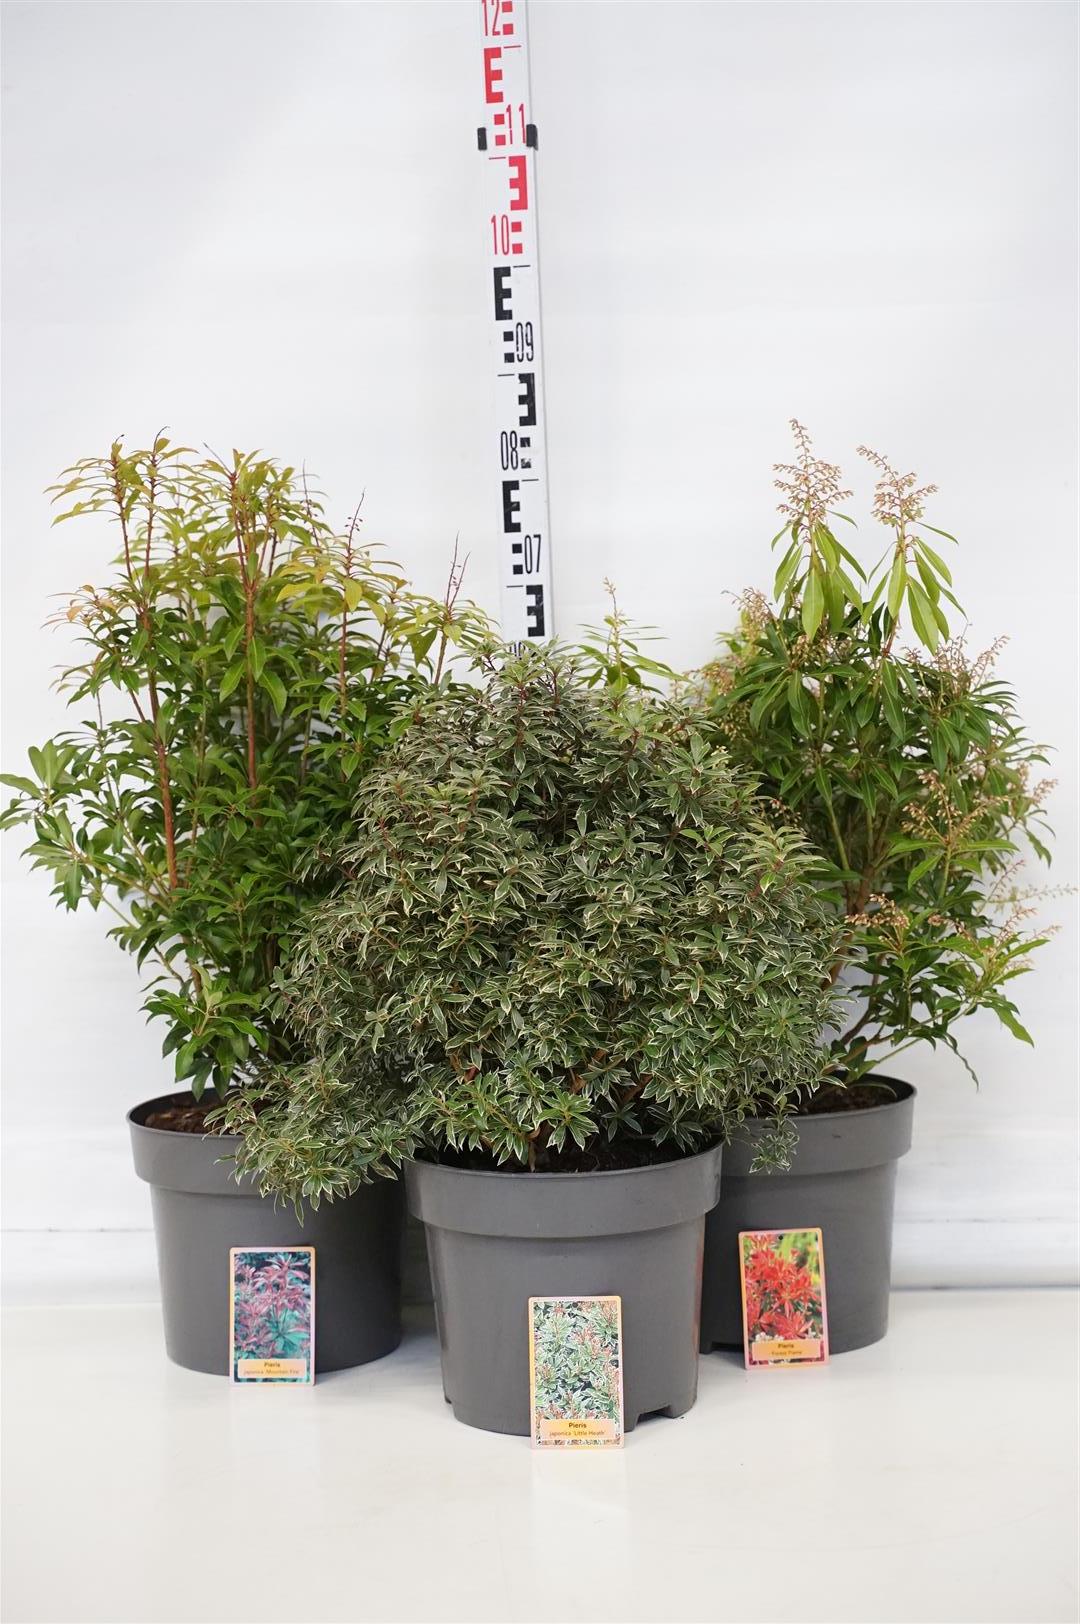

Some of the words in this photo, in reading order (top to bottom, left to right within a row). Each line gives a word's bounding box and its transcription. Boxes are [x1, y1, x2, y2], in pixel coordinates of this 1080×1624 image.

[481, 0, 500, 36] 12
[506, 103, 527, 145] 11
[490, 214, 510, 256] 10
[515, 321, 535, 363] 09
[500, 430, 519, 471] 08
[524, 533, 542, 574] 07
